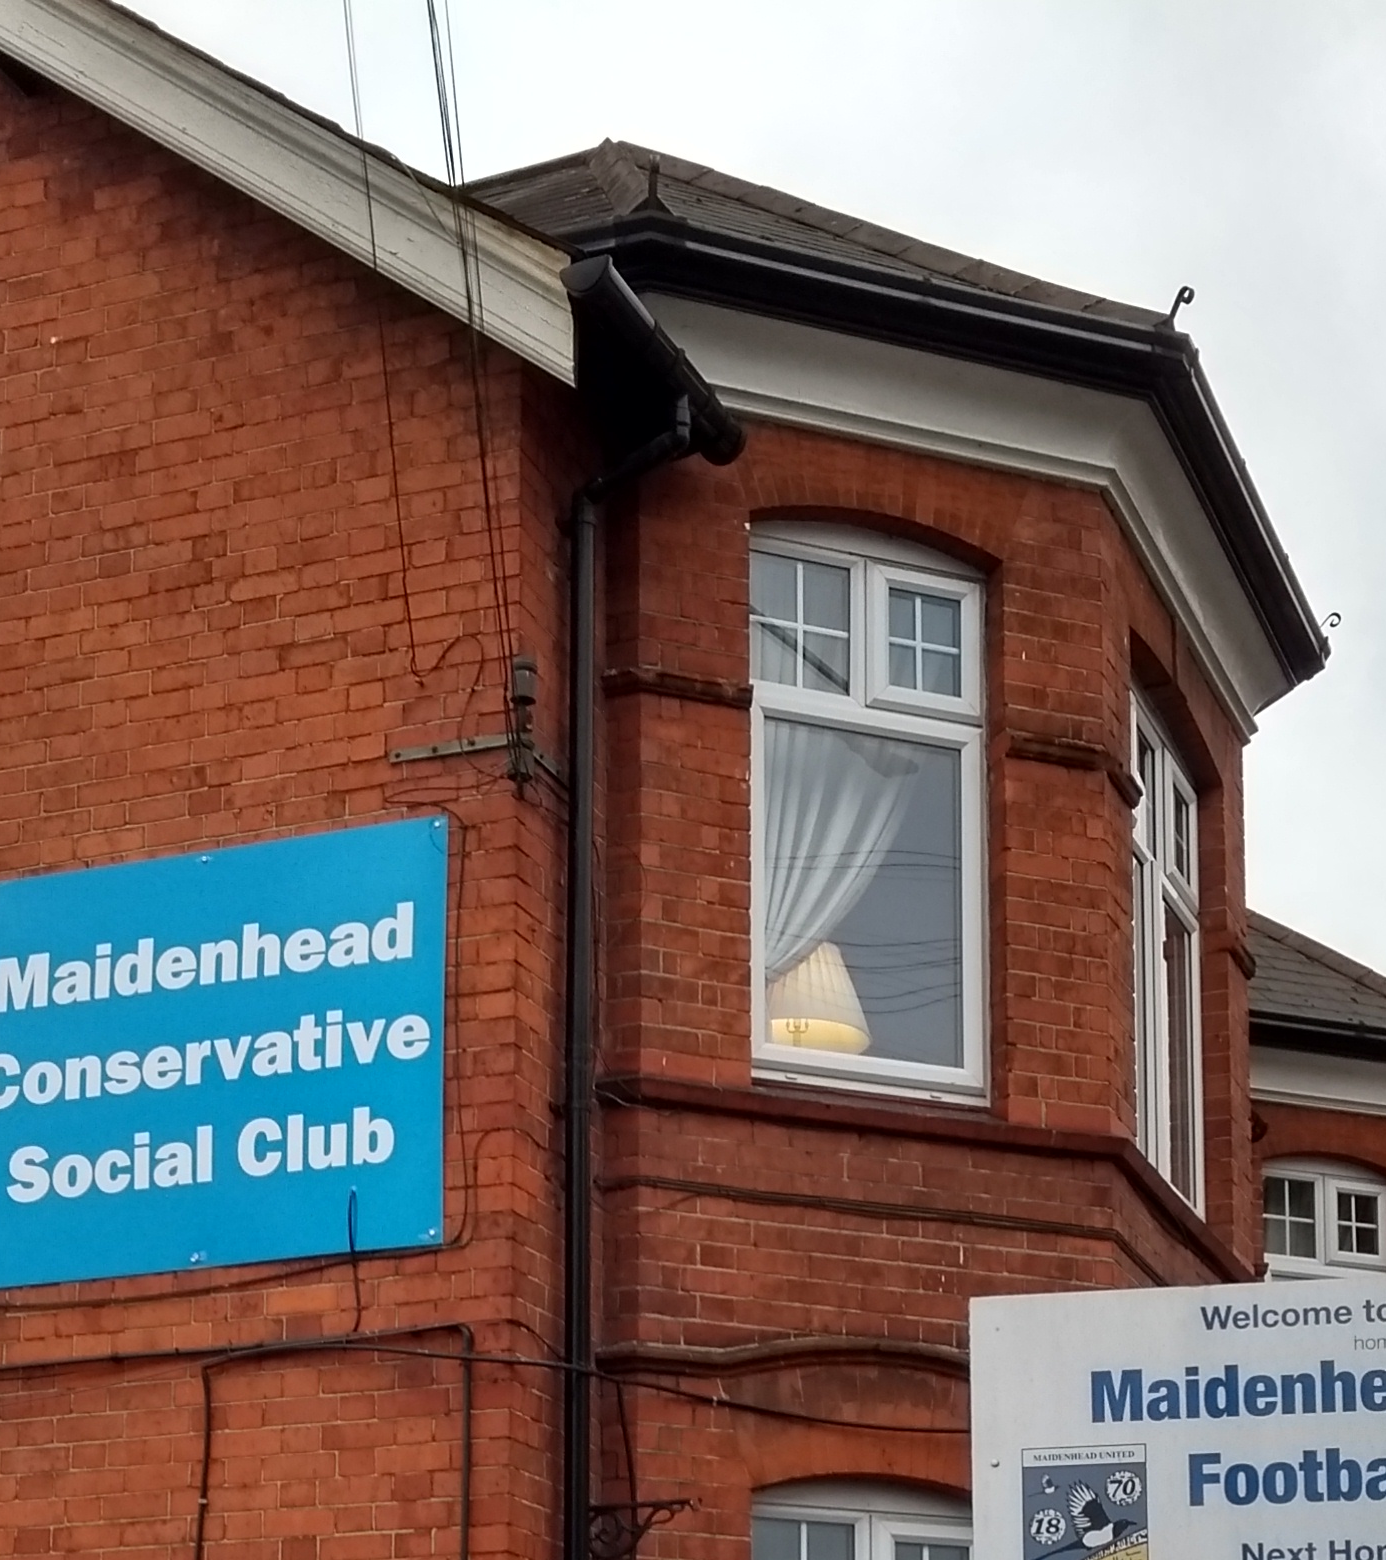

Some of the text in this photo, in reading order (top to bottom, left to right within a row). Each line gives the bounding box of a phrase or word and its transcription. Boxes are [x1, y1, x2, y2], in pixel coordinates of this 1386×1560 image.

[7, 1107, 394, 1203] Social Club
[1201, 1299, 1352, 1331] Welcome
[1033, 1451, 1135, 1462] MAIDENHEAD UNITED
[1110, 1479, 1135, 1498] 70
[1033, 1518, 1061, 1535] 18
